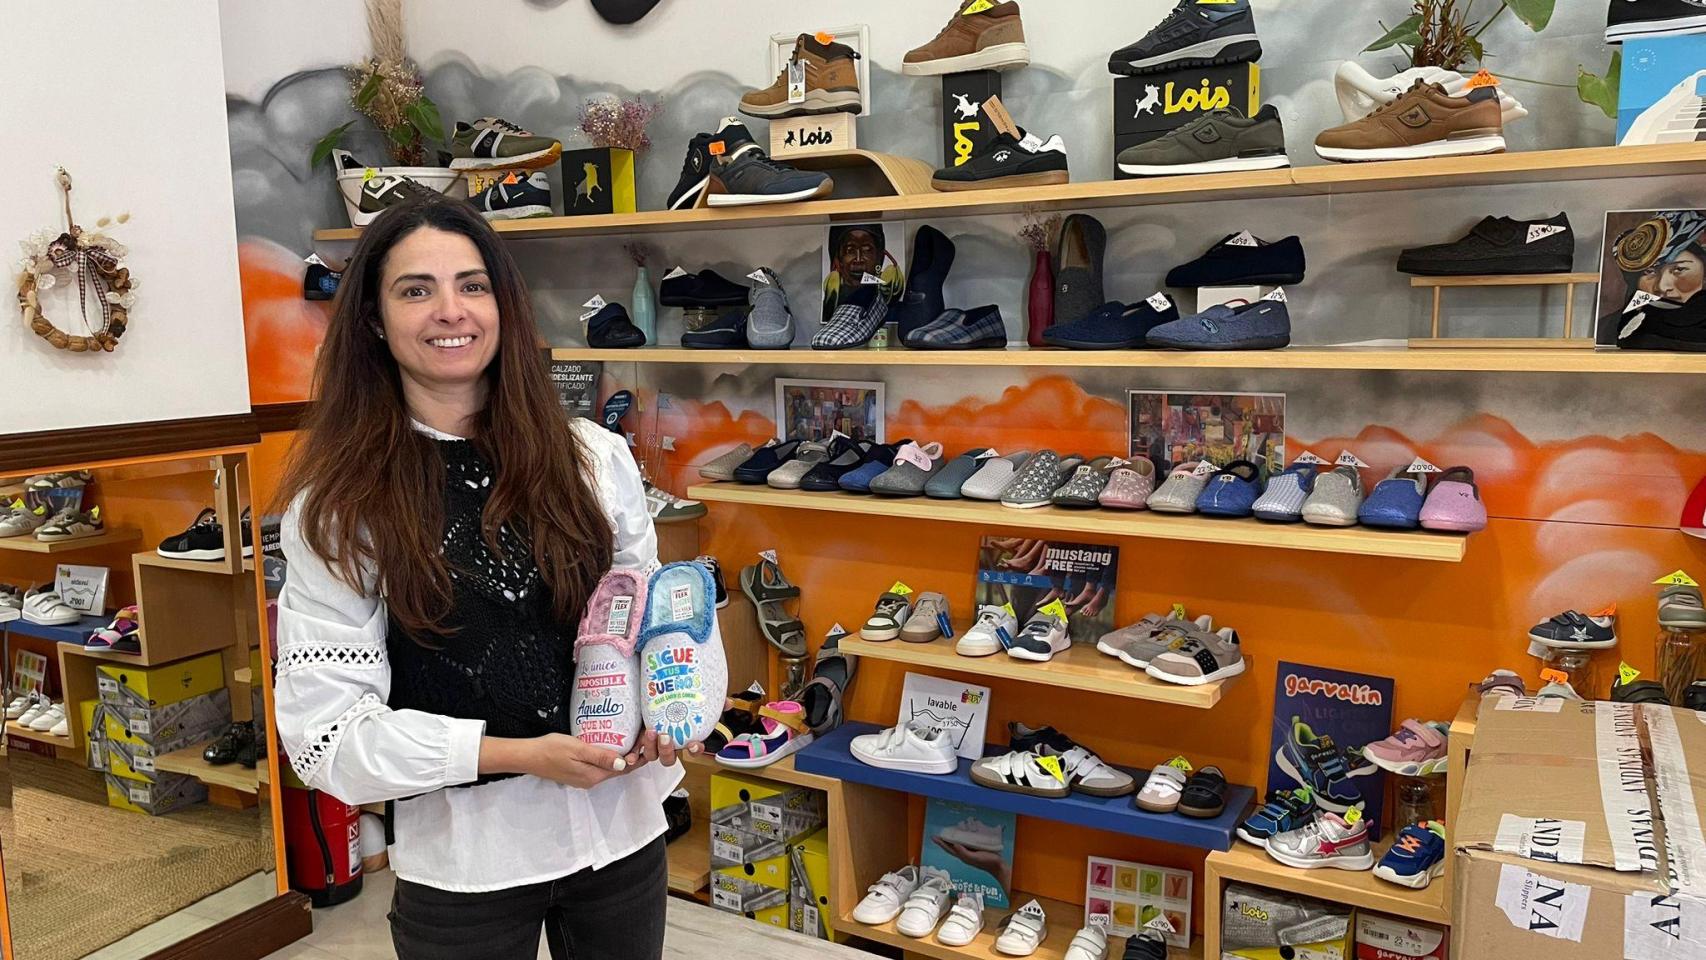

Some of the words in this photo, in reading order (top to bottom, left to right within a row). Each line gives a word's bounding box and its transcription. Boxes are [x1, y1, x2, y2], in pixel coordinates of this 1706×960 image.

[1164, 78, 1230, 115] Lois
[800, 126, 833, 146] Lois
[551, 365, 581, 373] CALZADO
[1044, 559, 1074, 572] FREE
[1045, 547, 1112, 566] mustang
[647, 648, 694, 671] SIGUE
[666, 667, 680, 675] TUS
[647, 673, 701, 697] SUEÑOS
[1284, 673, 1382, 706] garvalín
[577, 697, 624, 721] Aquello
[927, 696, 958, 711] lavable
[581, 720, 597, 732] QUE
[599, 719, 613, 730] NO
[1520, 879, 1533, 910] Slippers
[1241, 903, 1268, 920] Lois
[1394, 934, 1403, 946] 22
